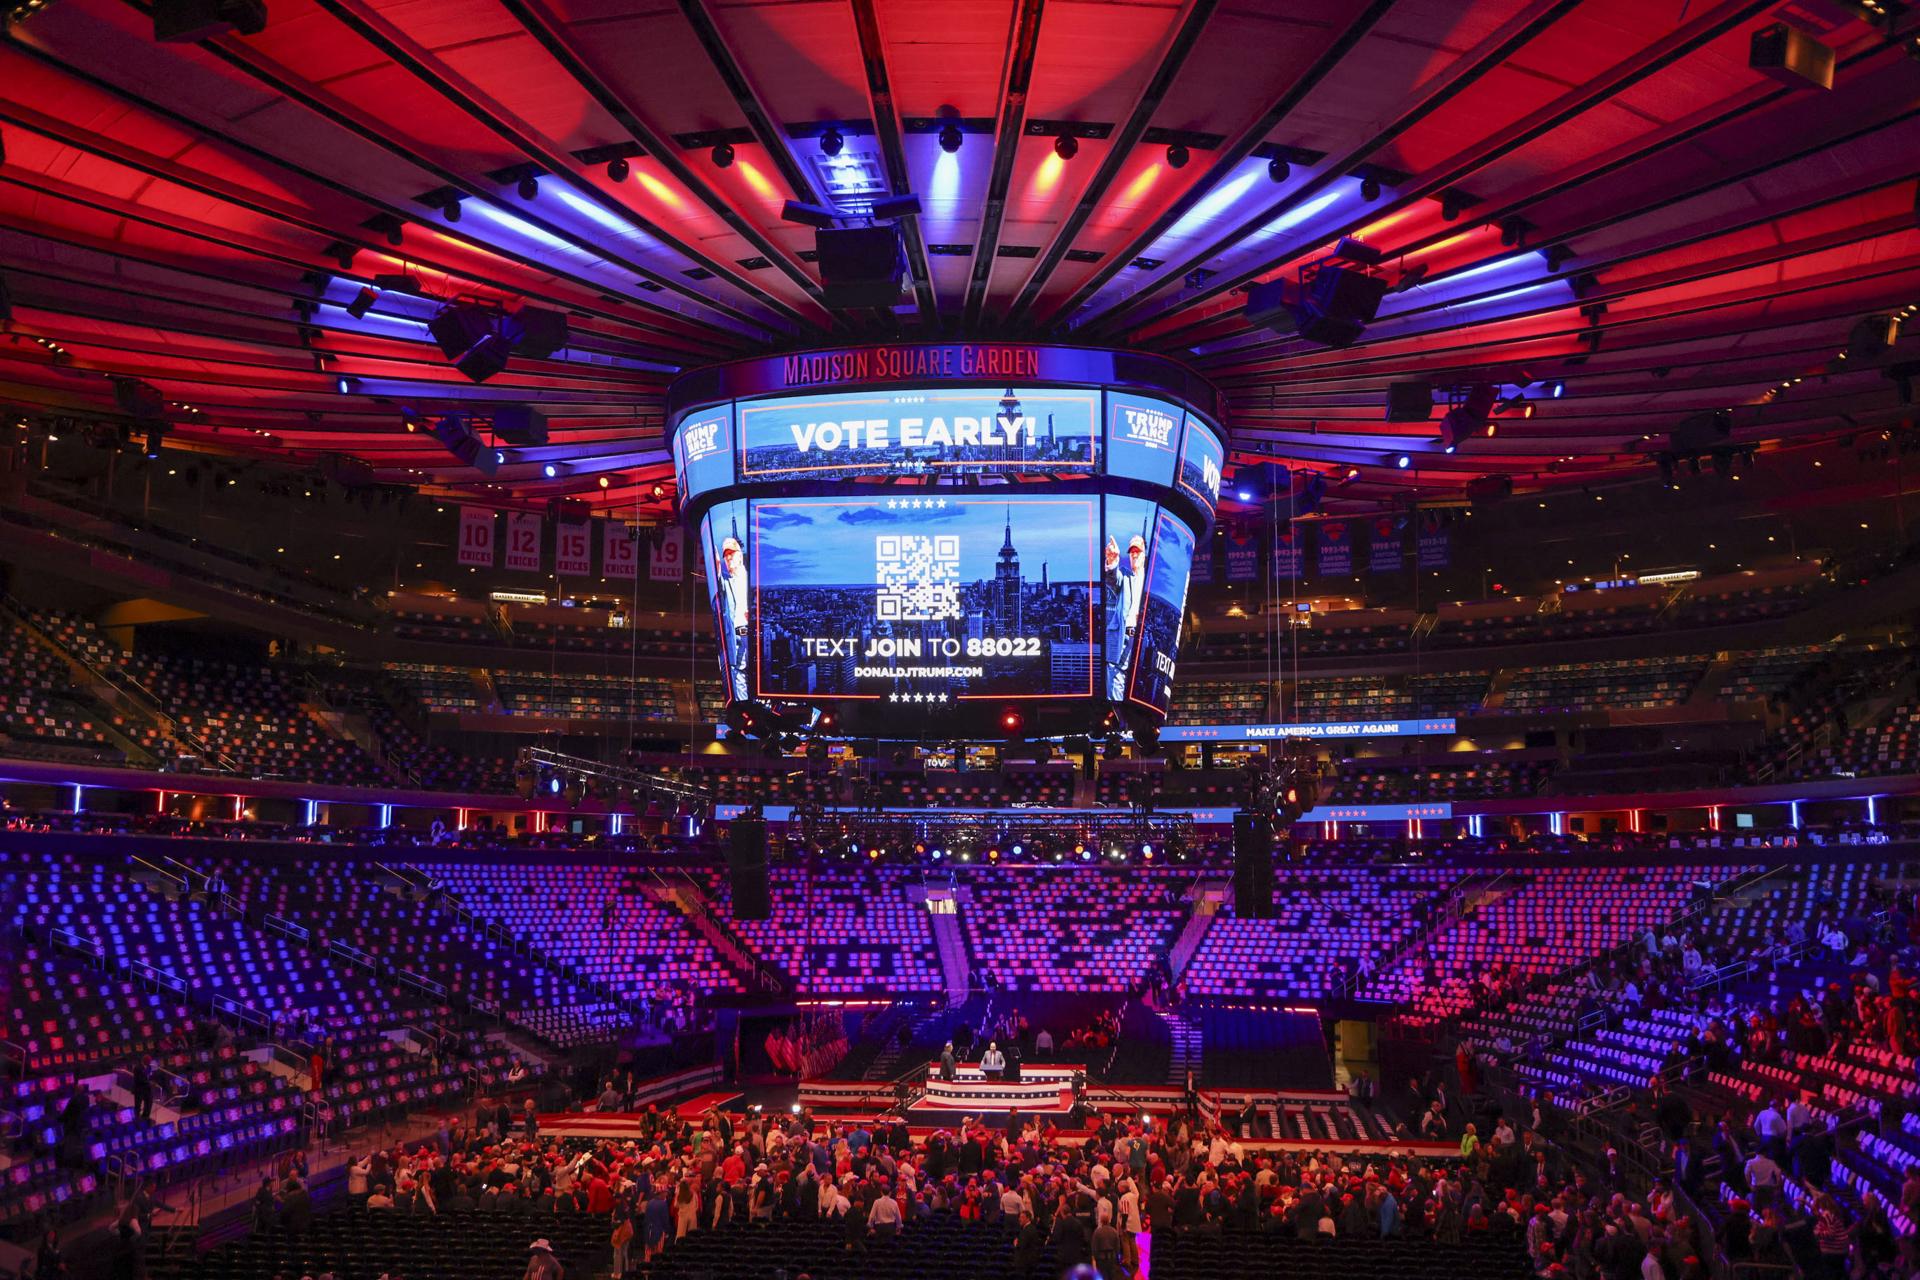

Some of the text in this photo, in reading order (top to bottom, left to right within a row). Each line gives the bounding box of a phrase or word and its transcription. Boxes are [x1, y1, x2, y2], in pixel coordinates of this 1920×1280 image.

[783, 346, 1039, 385] MADISON SQUARE GARDEN
[1125, 410, 1173, 430] TRUMP
[790, 416, 1036, 452] VOTE EARLY!
[1131, 423, 1169, 441] VANCE
[464, 524, 489, 548] 10
[512, 529, 536, 553] 12
[562, 534, 585, 557] 15
[460, 550, 492, 563] KNICKS
[609, 538, 632, 561] 15
[655, 541, 679, 563] 19
[507, 555, 538, 568] KNICKS
[558, 560, 588, 573] KNICKS
[605, 563, 635, 575] KNICKS
[651, 566, 681, 577] KNICKS
[803, 638, 1041, 657] TEXT JOIN TO 88022
[854, 667, 983, 678] DONALDJTRUMP.COM
[1246, 724, 1399, 737] MAKE AMERICA GREAT AGAIN!
